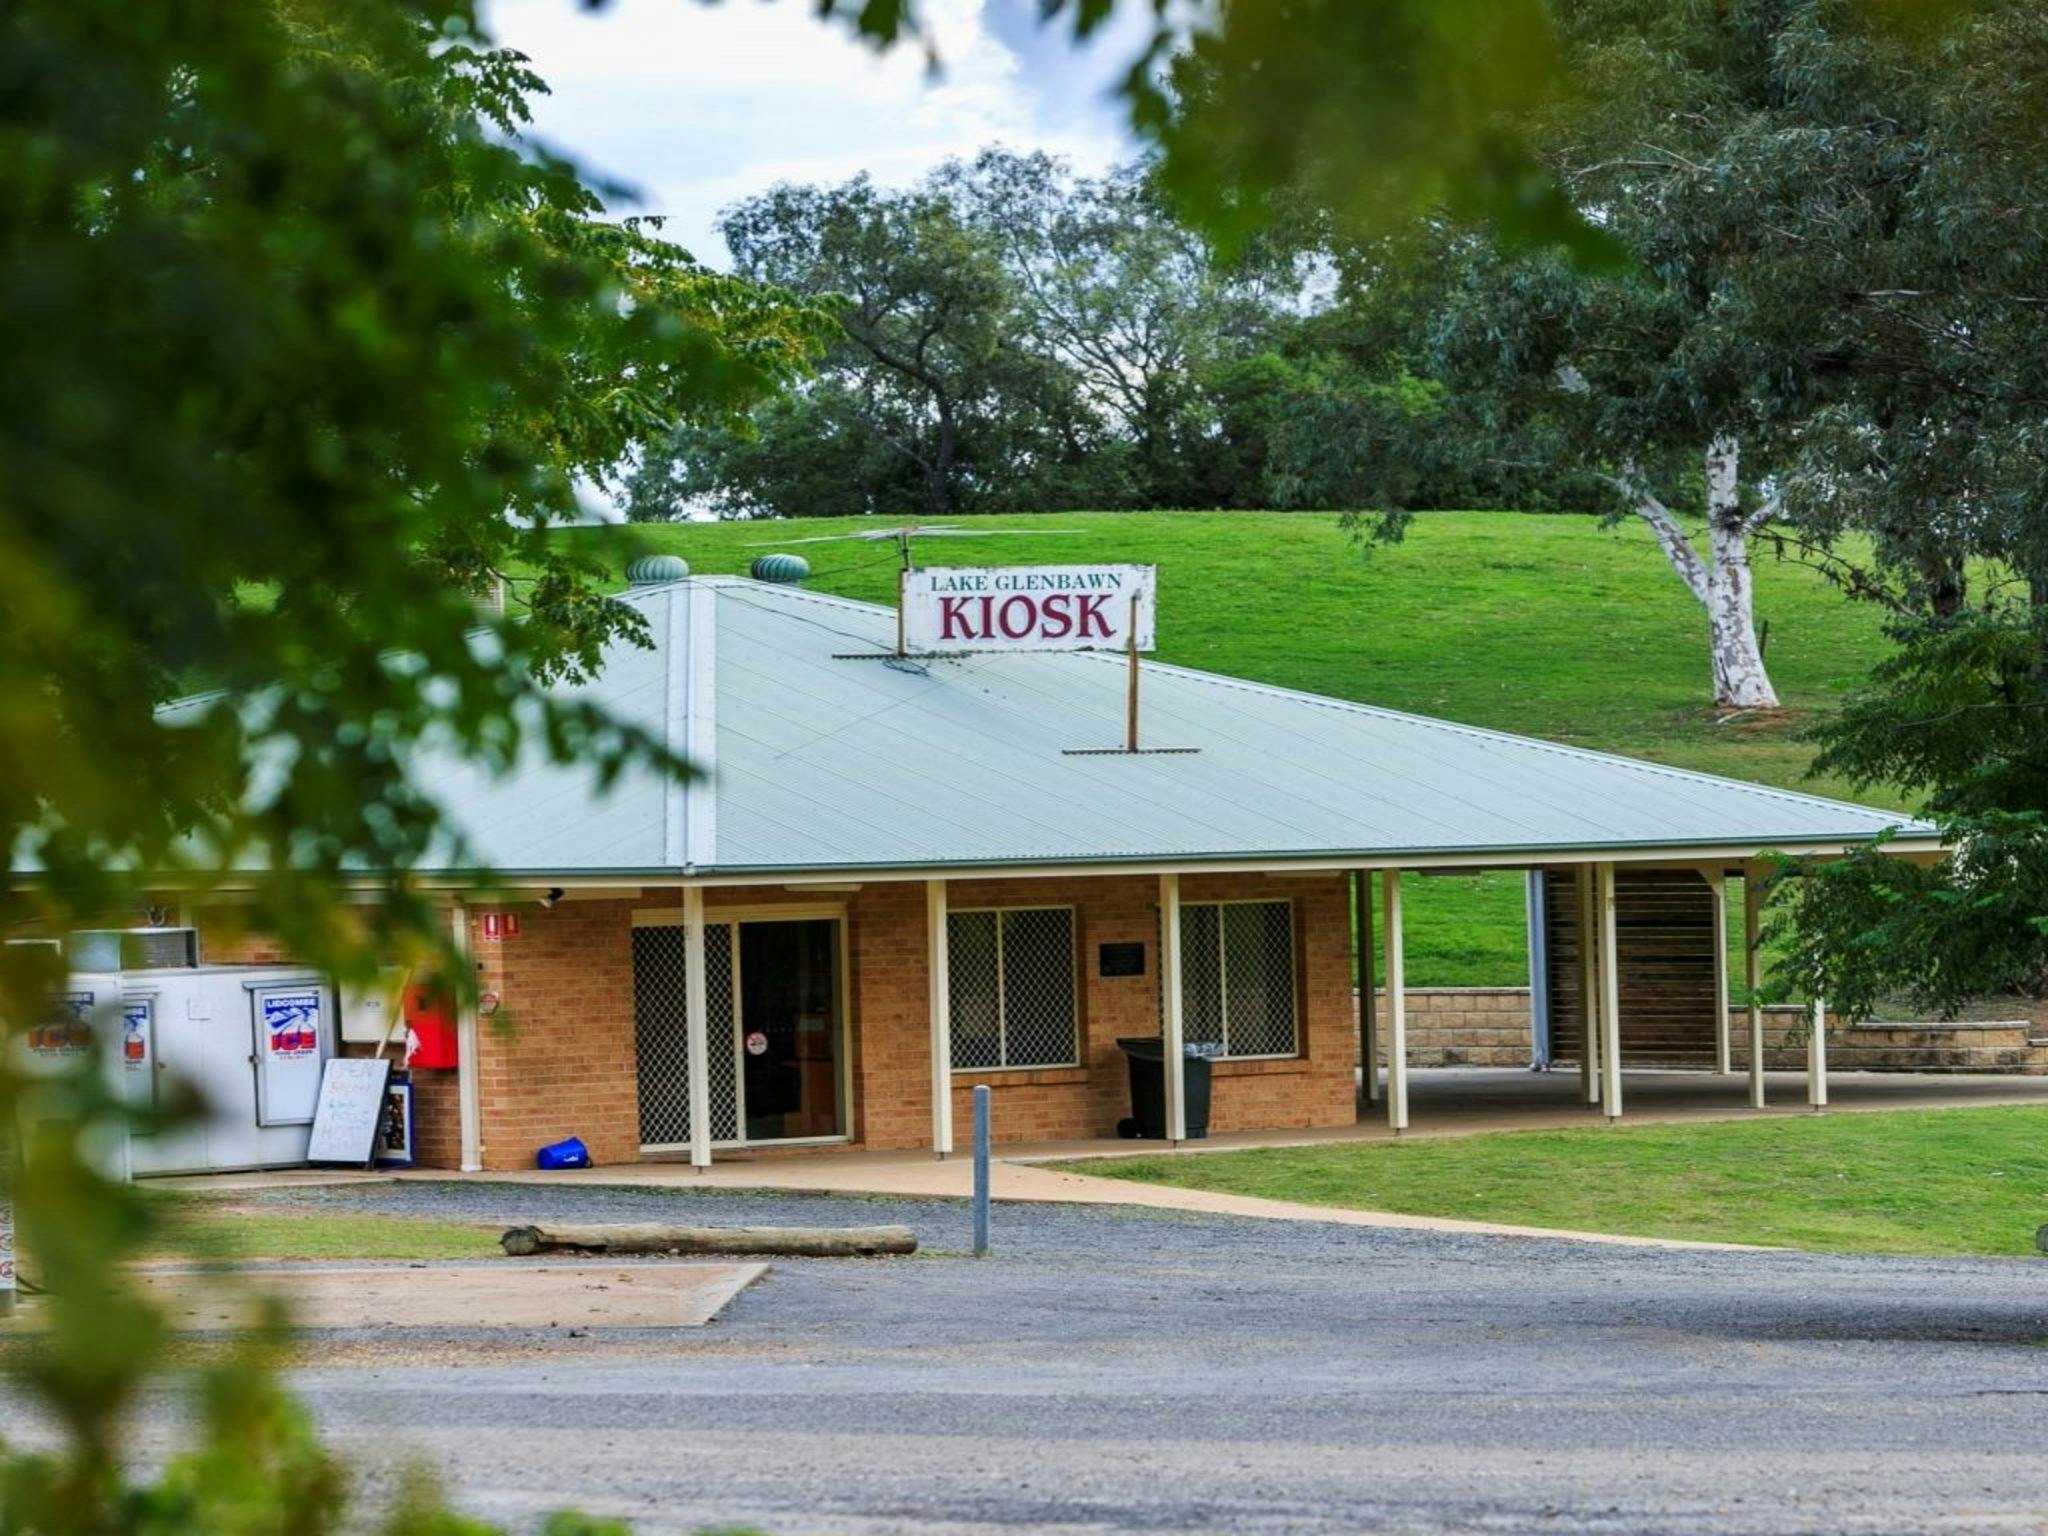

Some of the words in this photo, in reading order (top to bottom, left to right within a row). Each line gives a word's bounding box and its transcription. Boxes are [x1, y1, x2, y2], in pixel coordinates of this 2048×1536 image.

[931, 575, 988, 592] LAKE
[995, 573, 1122, 591] GLENBAWN
[938, 594, 1117, 640] KIOSK
[272, 1031, 316, 1051] ICE
